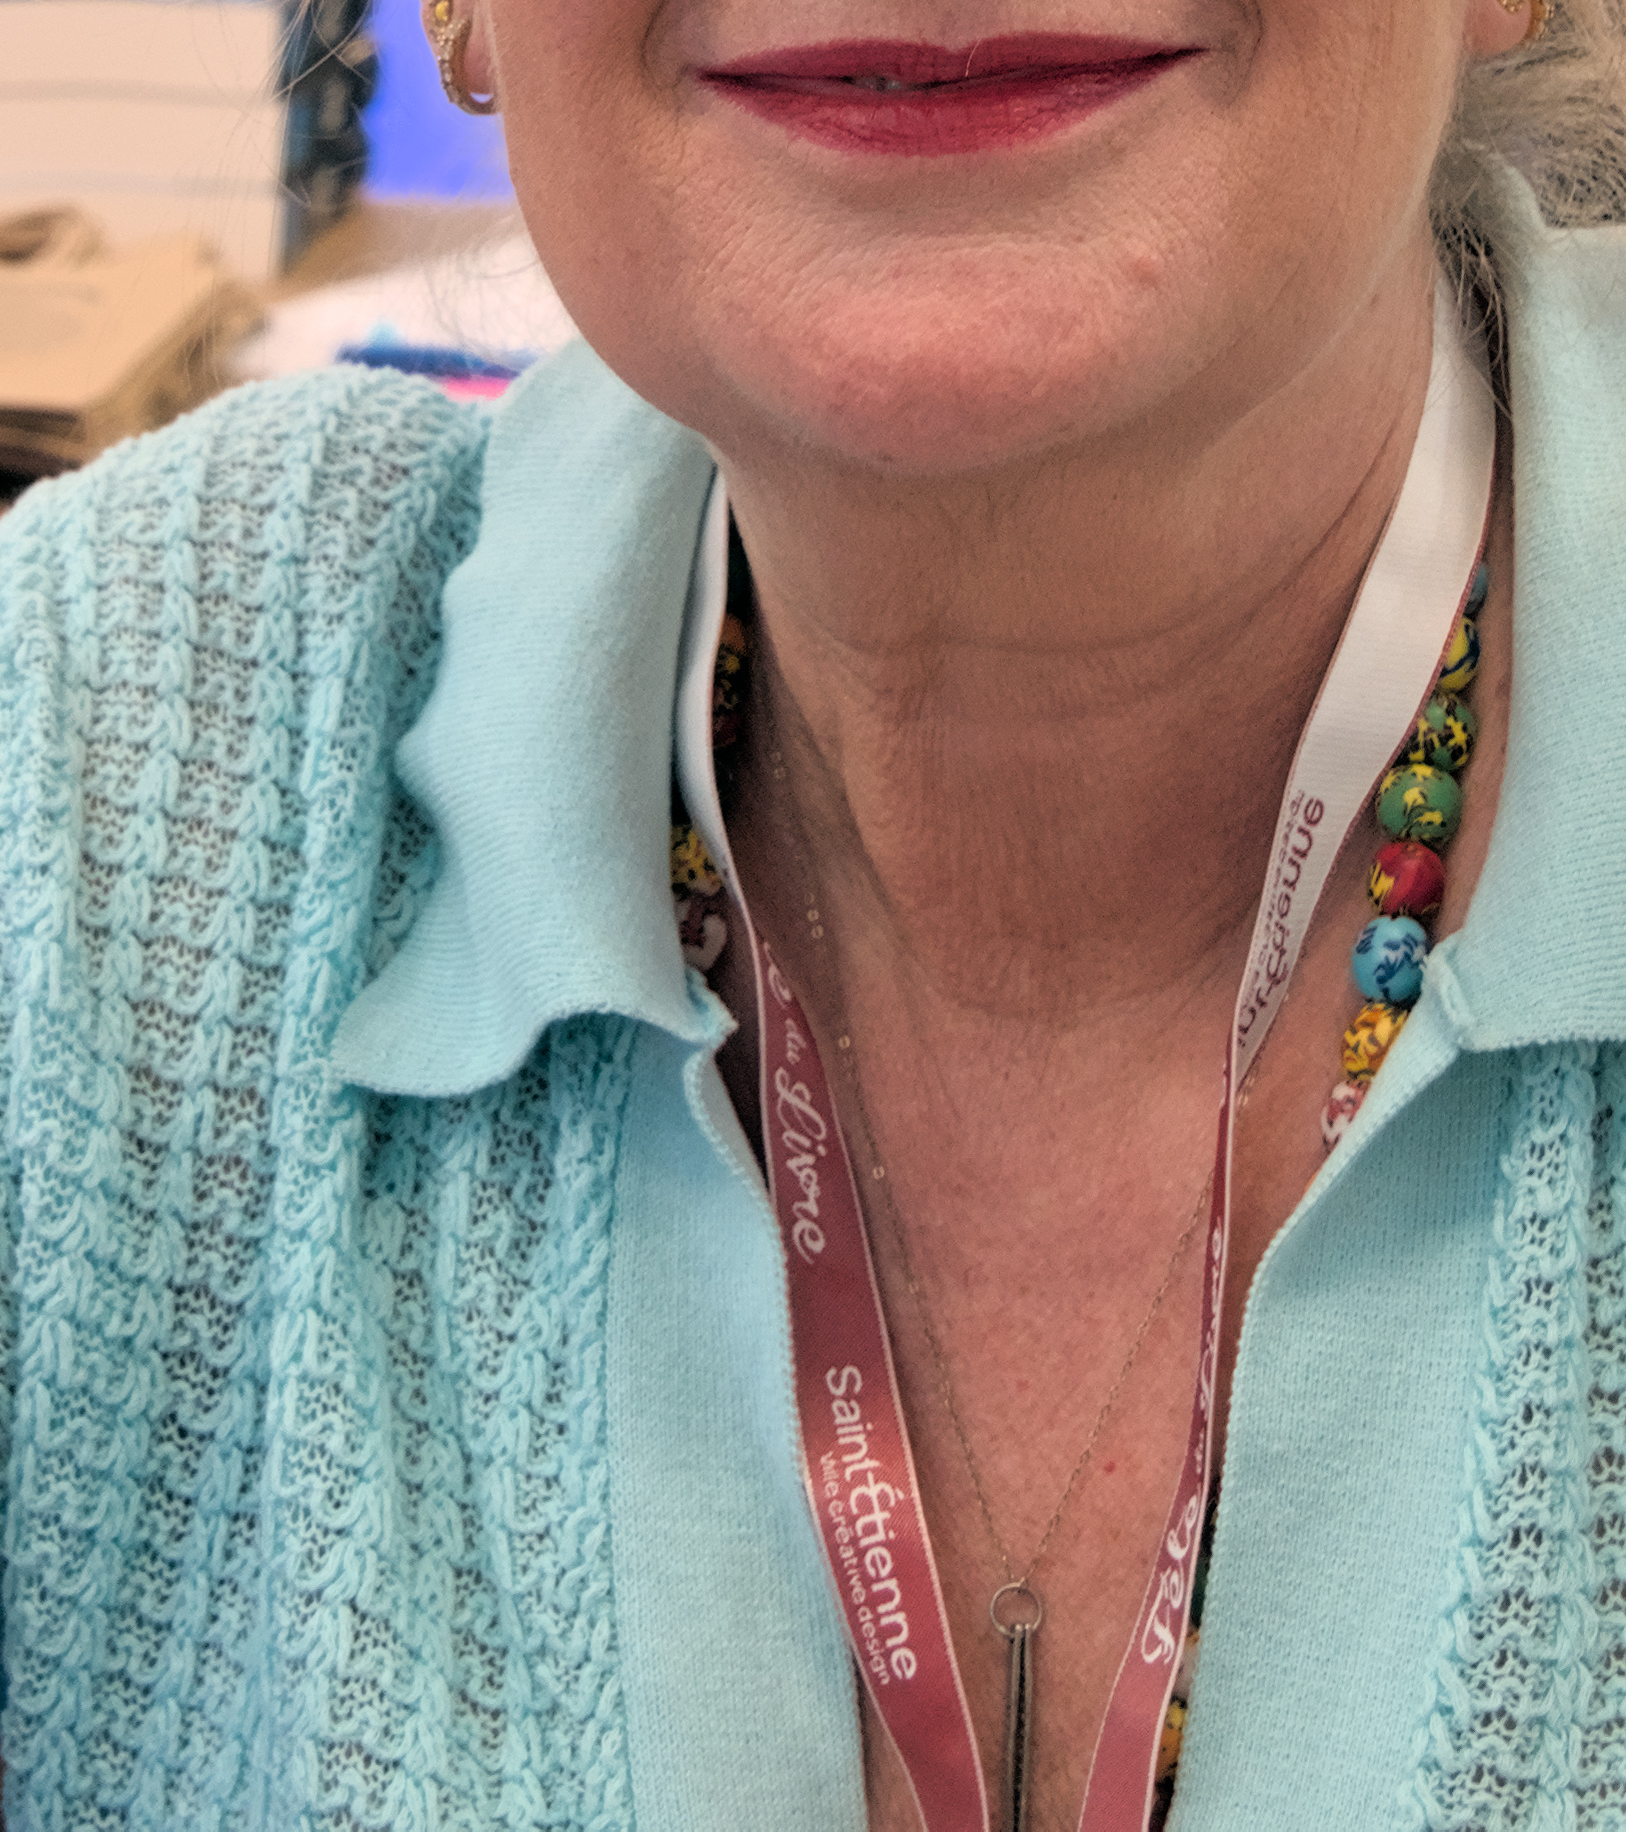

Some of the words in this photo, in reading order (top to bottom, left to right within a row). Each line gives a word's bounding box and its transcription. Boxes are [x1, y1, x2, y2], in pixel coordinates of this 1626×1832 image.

[785, 1018, 807, 1065] du
[775, 1067, 827, 1265] Livre
[825, 1365, 918, 1681] Saint-Étienne
[827, 1499, 867, 1605] créative
[856, 1605, 891, 1686] design
